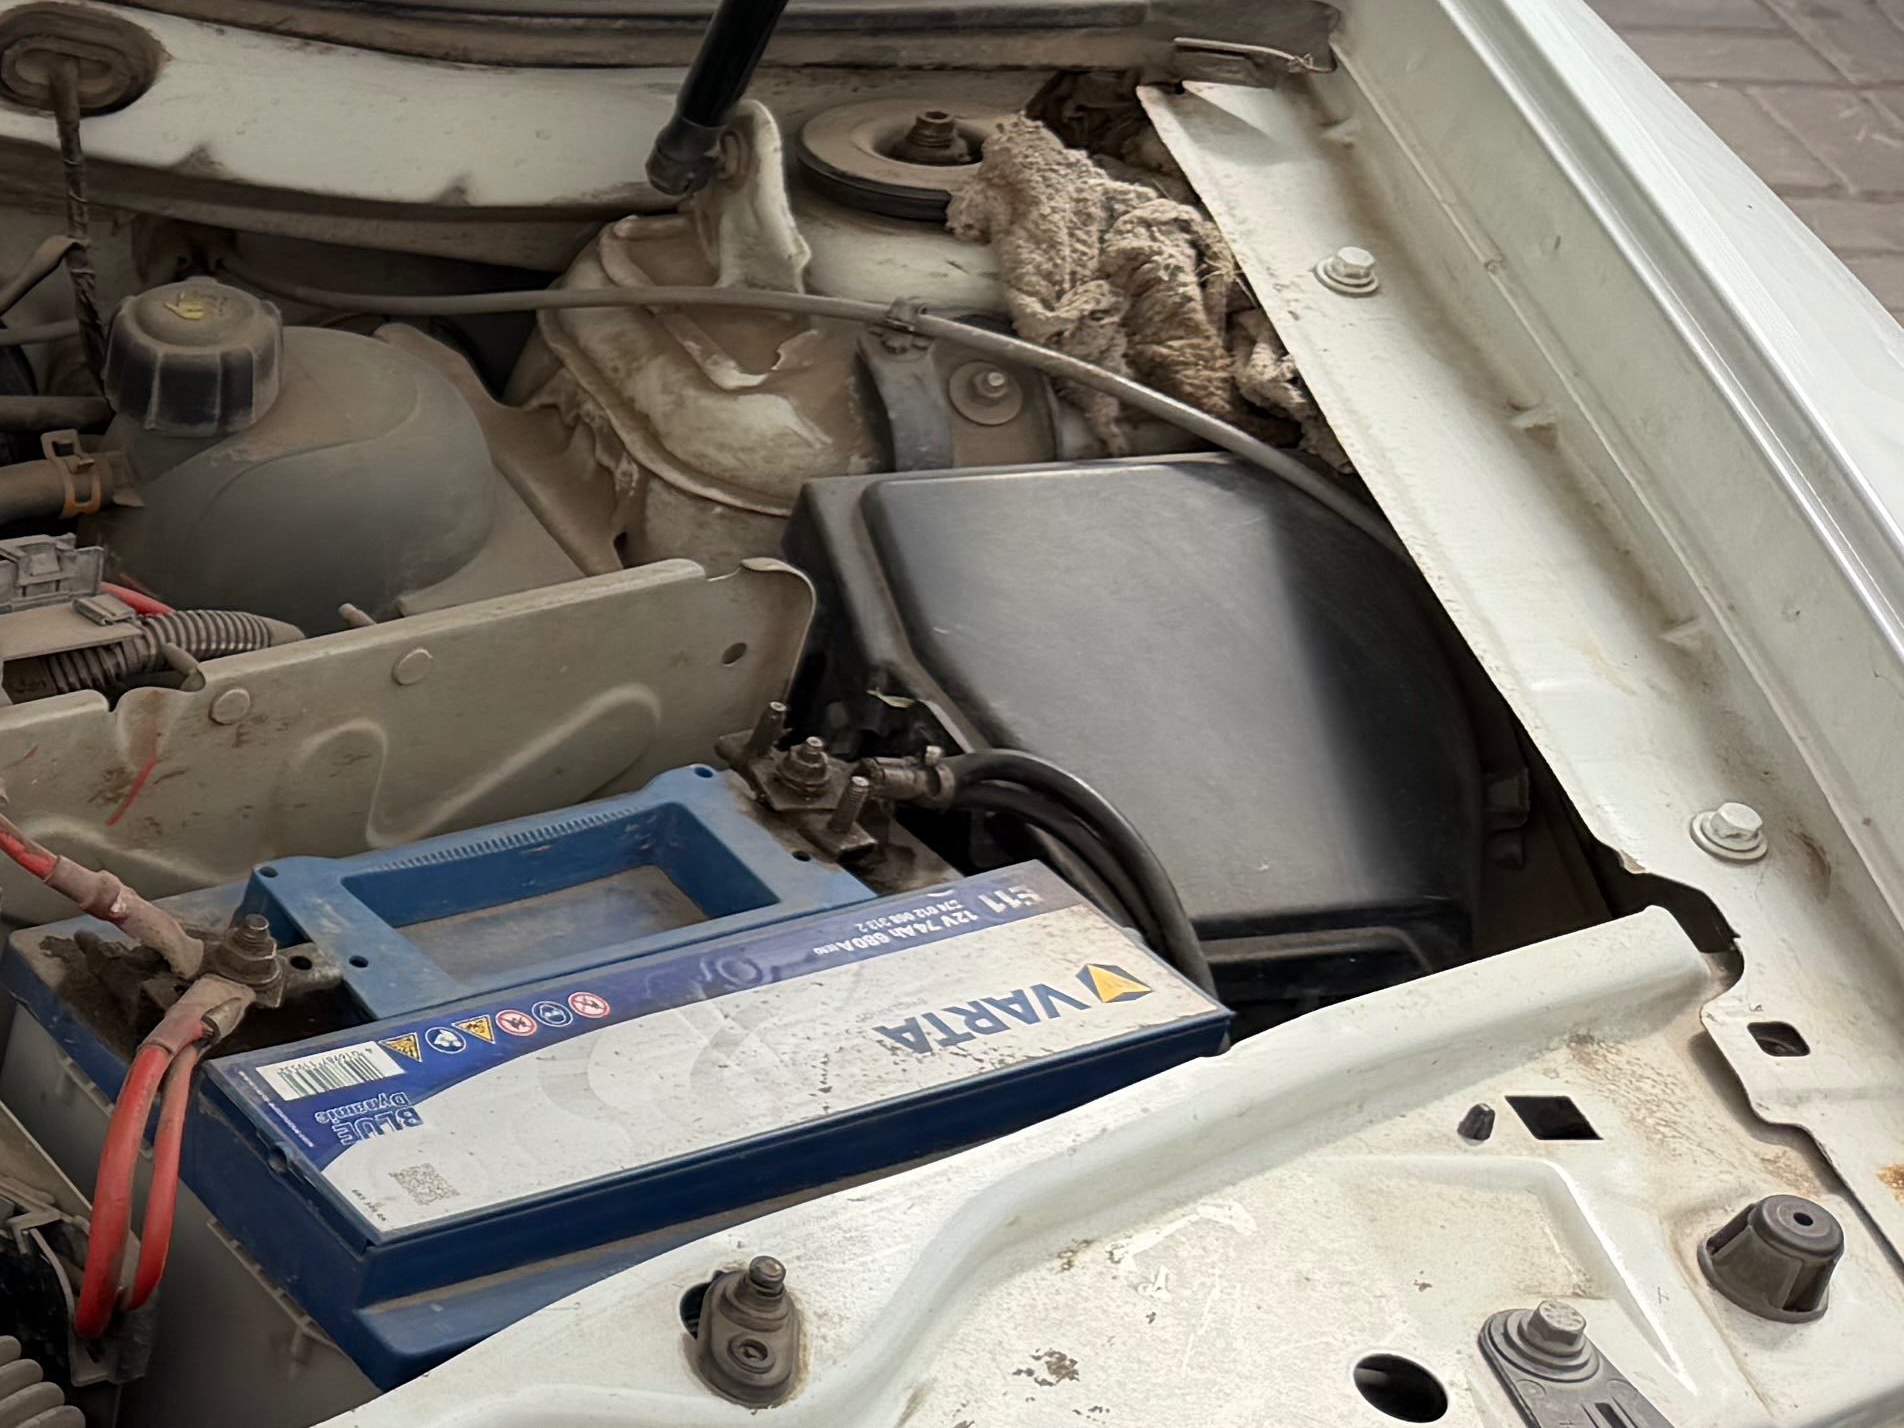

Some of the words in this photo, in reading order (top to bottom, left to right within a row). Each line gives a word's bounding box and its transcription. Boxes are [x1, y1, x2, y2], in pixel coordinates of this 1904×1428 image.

[888, 920, 941, 939] 74Ah
[941, 910, 979, 928] 12V
[837, 932, 890, 952] 680A
[872, 983, 1091, 1054] VARTA
[315, 1092, 410, 1123] Dynamic
[332, 1107, 424, 1146] BLUE
